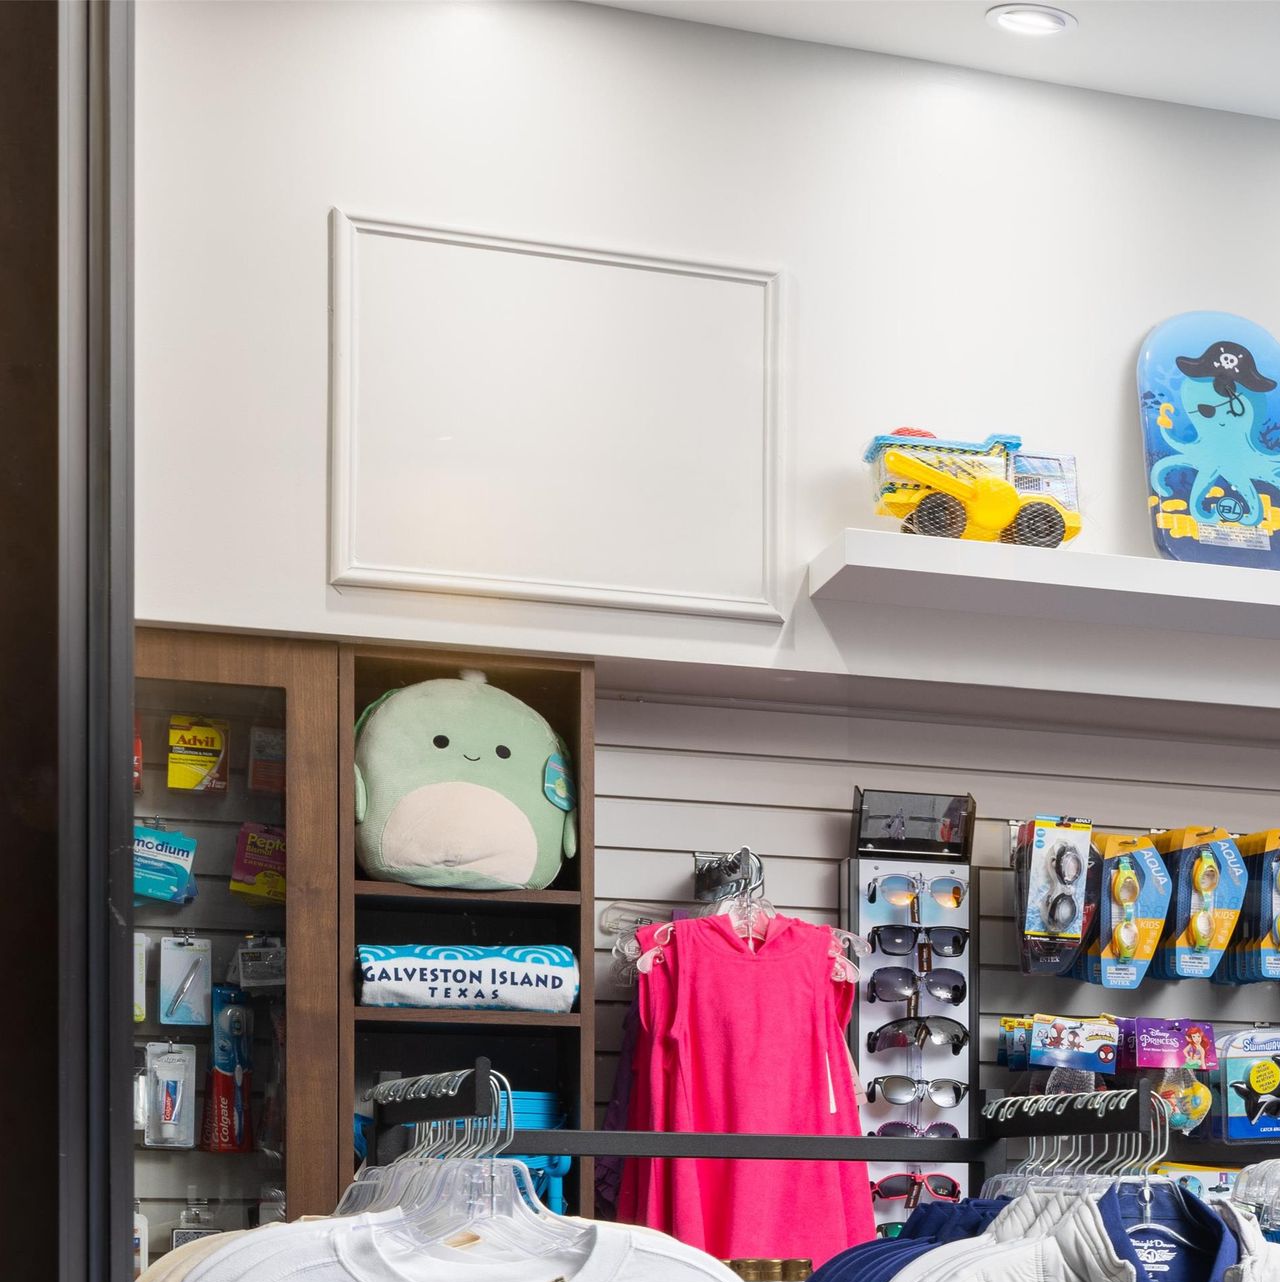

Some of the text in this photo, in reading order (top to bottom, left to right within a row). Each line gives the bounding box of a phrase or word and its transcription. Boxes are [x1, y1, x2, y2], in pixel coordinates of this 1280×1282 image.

[176, 734, 216, 748] Advil
[134, 837, 190, 859] modium
[1140, 850, 1168, 886] AQUA
[1217, 841, 1244, 877] AQUA
[1214, 911, 1235, 919] KIDS
[1139, 920, 1160, 929] KIDS
[364, 966, 564, 990] GALVESTON ISLAND
[428, 987, 499, 1000] TEXAS
[1139, 1034, 1180, 1047] PRINCESS
[1148, 1027, 1170, 1038] Disney
[164, 1096, 172, 1120] Colgate
[220, 1097, 229, 1143] Colgate
